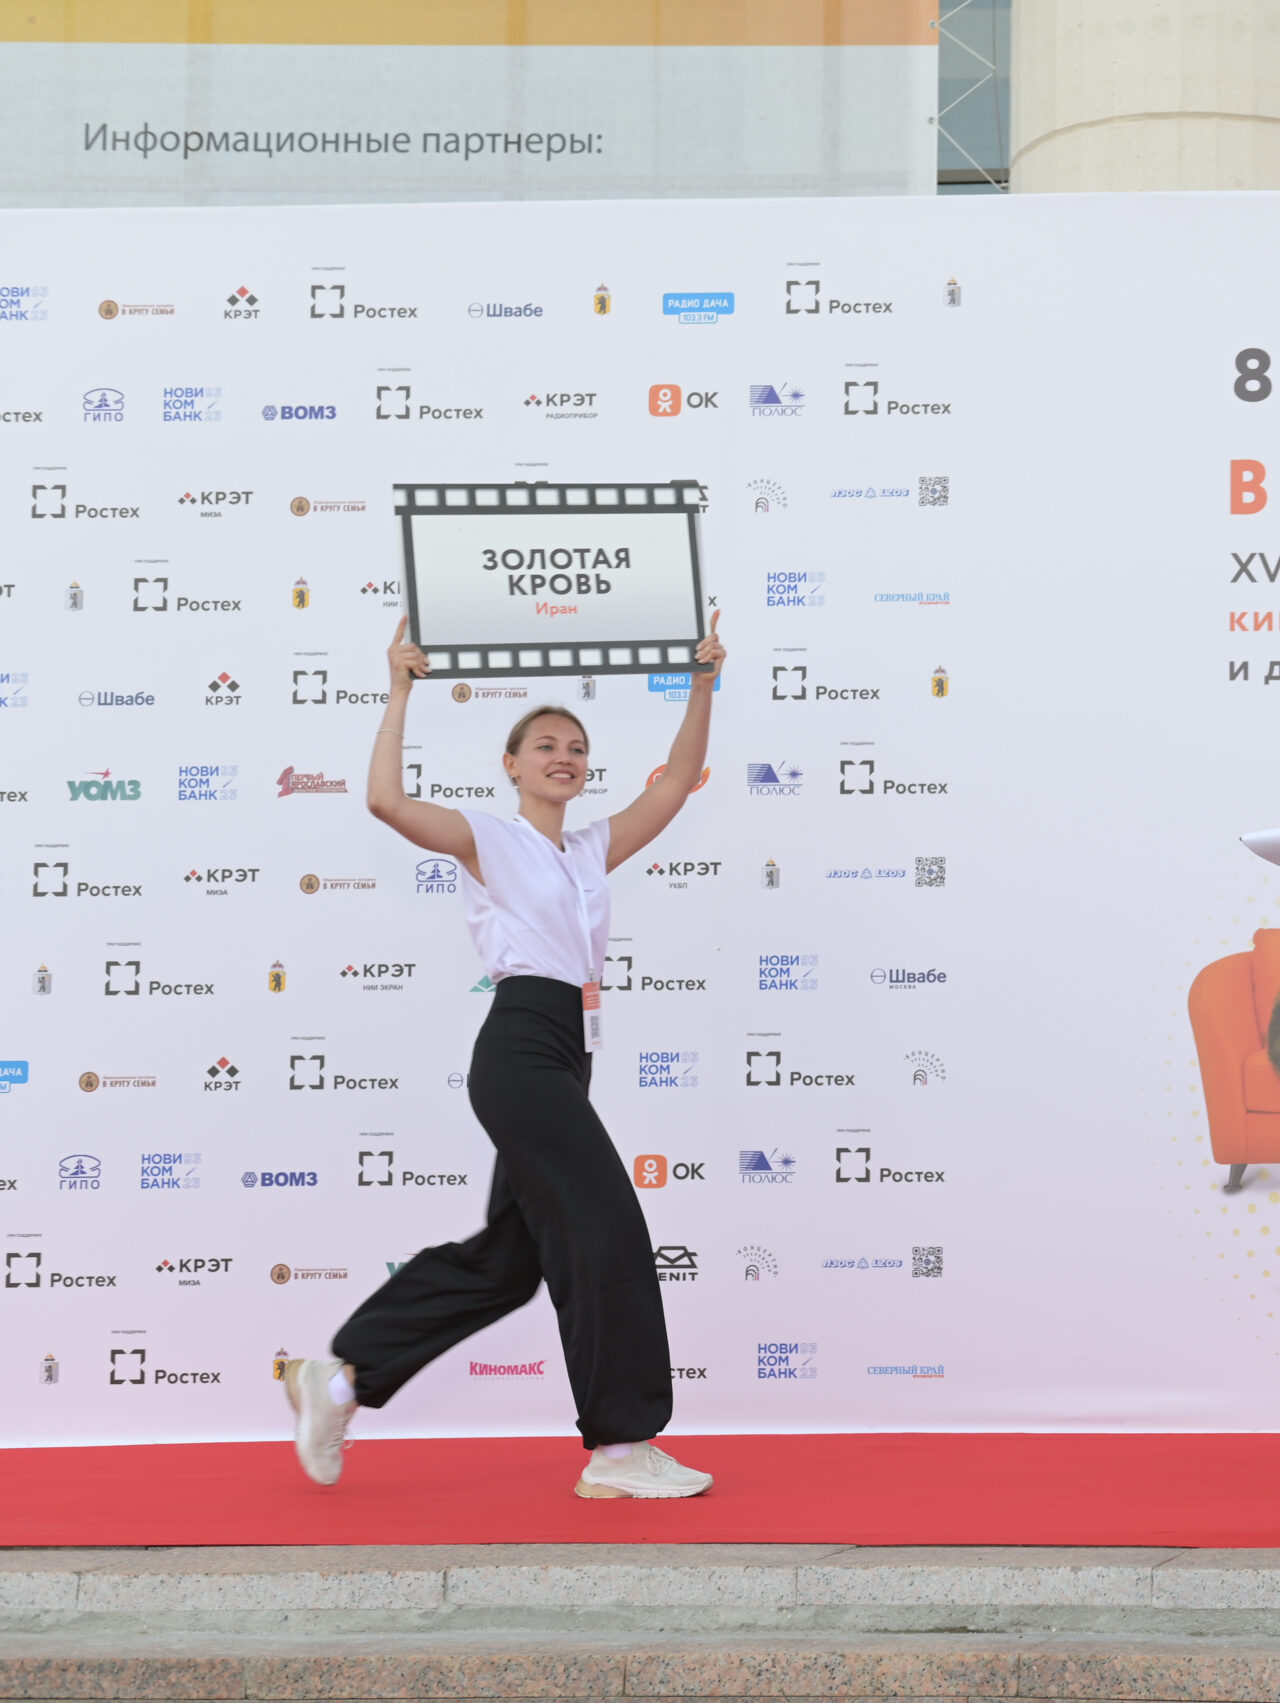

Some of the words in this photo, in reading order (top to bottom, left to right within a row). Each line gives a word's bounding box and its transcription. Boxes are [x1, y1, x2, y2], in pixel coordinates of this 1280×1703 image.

[85, 122, 411, 160] Информационные
[420, 126, 603, 158] партнеры:
[668, 298, 700, 309] РАДИО
[702, 297, 729, 309] ДАЧА
[829, 300, 892, 313] Ростех
[224, 310, 260, 319] КРЭТ
[354, 304, 417, 318] Ростех
[487, 303, 543, 317] Швабе
[1234, 348, 1272, 402] 8
[163, 400, 194, 410] КОМ
[546, 393, 596, 406] КРЭТ
[281, 406, 336, 420] ВОМЗ
[420, 406, 483, 419] Ростех
[749, 404, 804, 416] ПОЛЮС
[888, 401, 951, 414] Ростех
[84, 409, 123, 422] ГИПО
[1230, 459, 1267, 515] В
[201, 491, 253, 504] КРЭТ
[75, 505, 139, 518] Ростех
[482, 548, 630, 570] ЗОЛОТАЯ
[767, 572, 807, 583] НОВИ
[509, 574, 611, 595] КРОВЬ
[767, 584, 798, 594] КОМ
[767, 596, 806, 606] БАНК
[874, 591, 926, 603] СЕВЕРНЫЙ
[929, 591, 950, 602] КРАЙ
[177, 597, 241, 611] Ростех
[536, 602, 578, 617] Иран
[1229, 661, 1248, 681] и
[653, 675, 686, 686] РАДИО
[98, 691, 155, 706] Швабе
[336, 690, 389, 704] Росте
[816, 686, 879, 700] Ростех
[206, 696, 241, 705] КРЭТ
[67, 776, 141, 801] УОМЗ
[179, 778, 210, 788] КОМ
[884, 780, 947, 794] Ростех
[431, 784, 494, 798] Ростех
[207, 869, 260, 882] КРЭТ
[669, 862, 721, 876] КРЭТ
[77, 883, 142, 896] Ростех
[417, 881, 456, 893] ГИПО
[759, 956, 799, 966] НОВИ
[364, 964, 416, 977] КРЭТ
[759, 967, 790, 977] КОМ
[890, 969, 946, 983] Швабе
[149, 981, 214, 995] Ростех
[642, 977, 705, 990] Ростех
[759, 979, 798, 990] БАНК
[639, 1052, 680, 1062] НОВИ
[639, 1064, 670, 1075] КОМ
[334, 1075, 398, 1089] Ростех
[639, 1077, 678, 1088] БАНК
[790, 1072, 855, 1086] Ростех
[204, 1081, 241, 1091] КРЭТ
[141, 1154, 182, 1164] НОВИ
[141, 1166, 173, 1176] КОМ
[739, 1171, 796, 1183] ПОЛЮС
[880, 1168, 944, 1182] Ростех
[141, 1178, 180, 1189] БАНК
[261, 1172, 318, 1186] ВОМЗ
[403, 1171, 467, 1185] Ростех
[180, 1259, 232, 1272] КРЭТ
[51, 1273, 116, 1287] Ростех
[658, 1272, 698, 1282] ENIT
[758, 1356, 789, 1366] КОМ
[669, 1366, 707, 1380] стех
[867, 1365, 917, 1375] СЕВЕРНЫЙ
[920, 1364, 944, 1375] КРАЙ
[155, 1370, 220, 1384] Ростех
